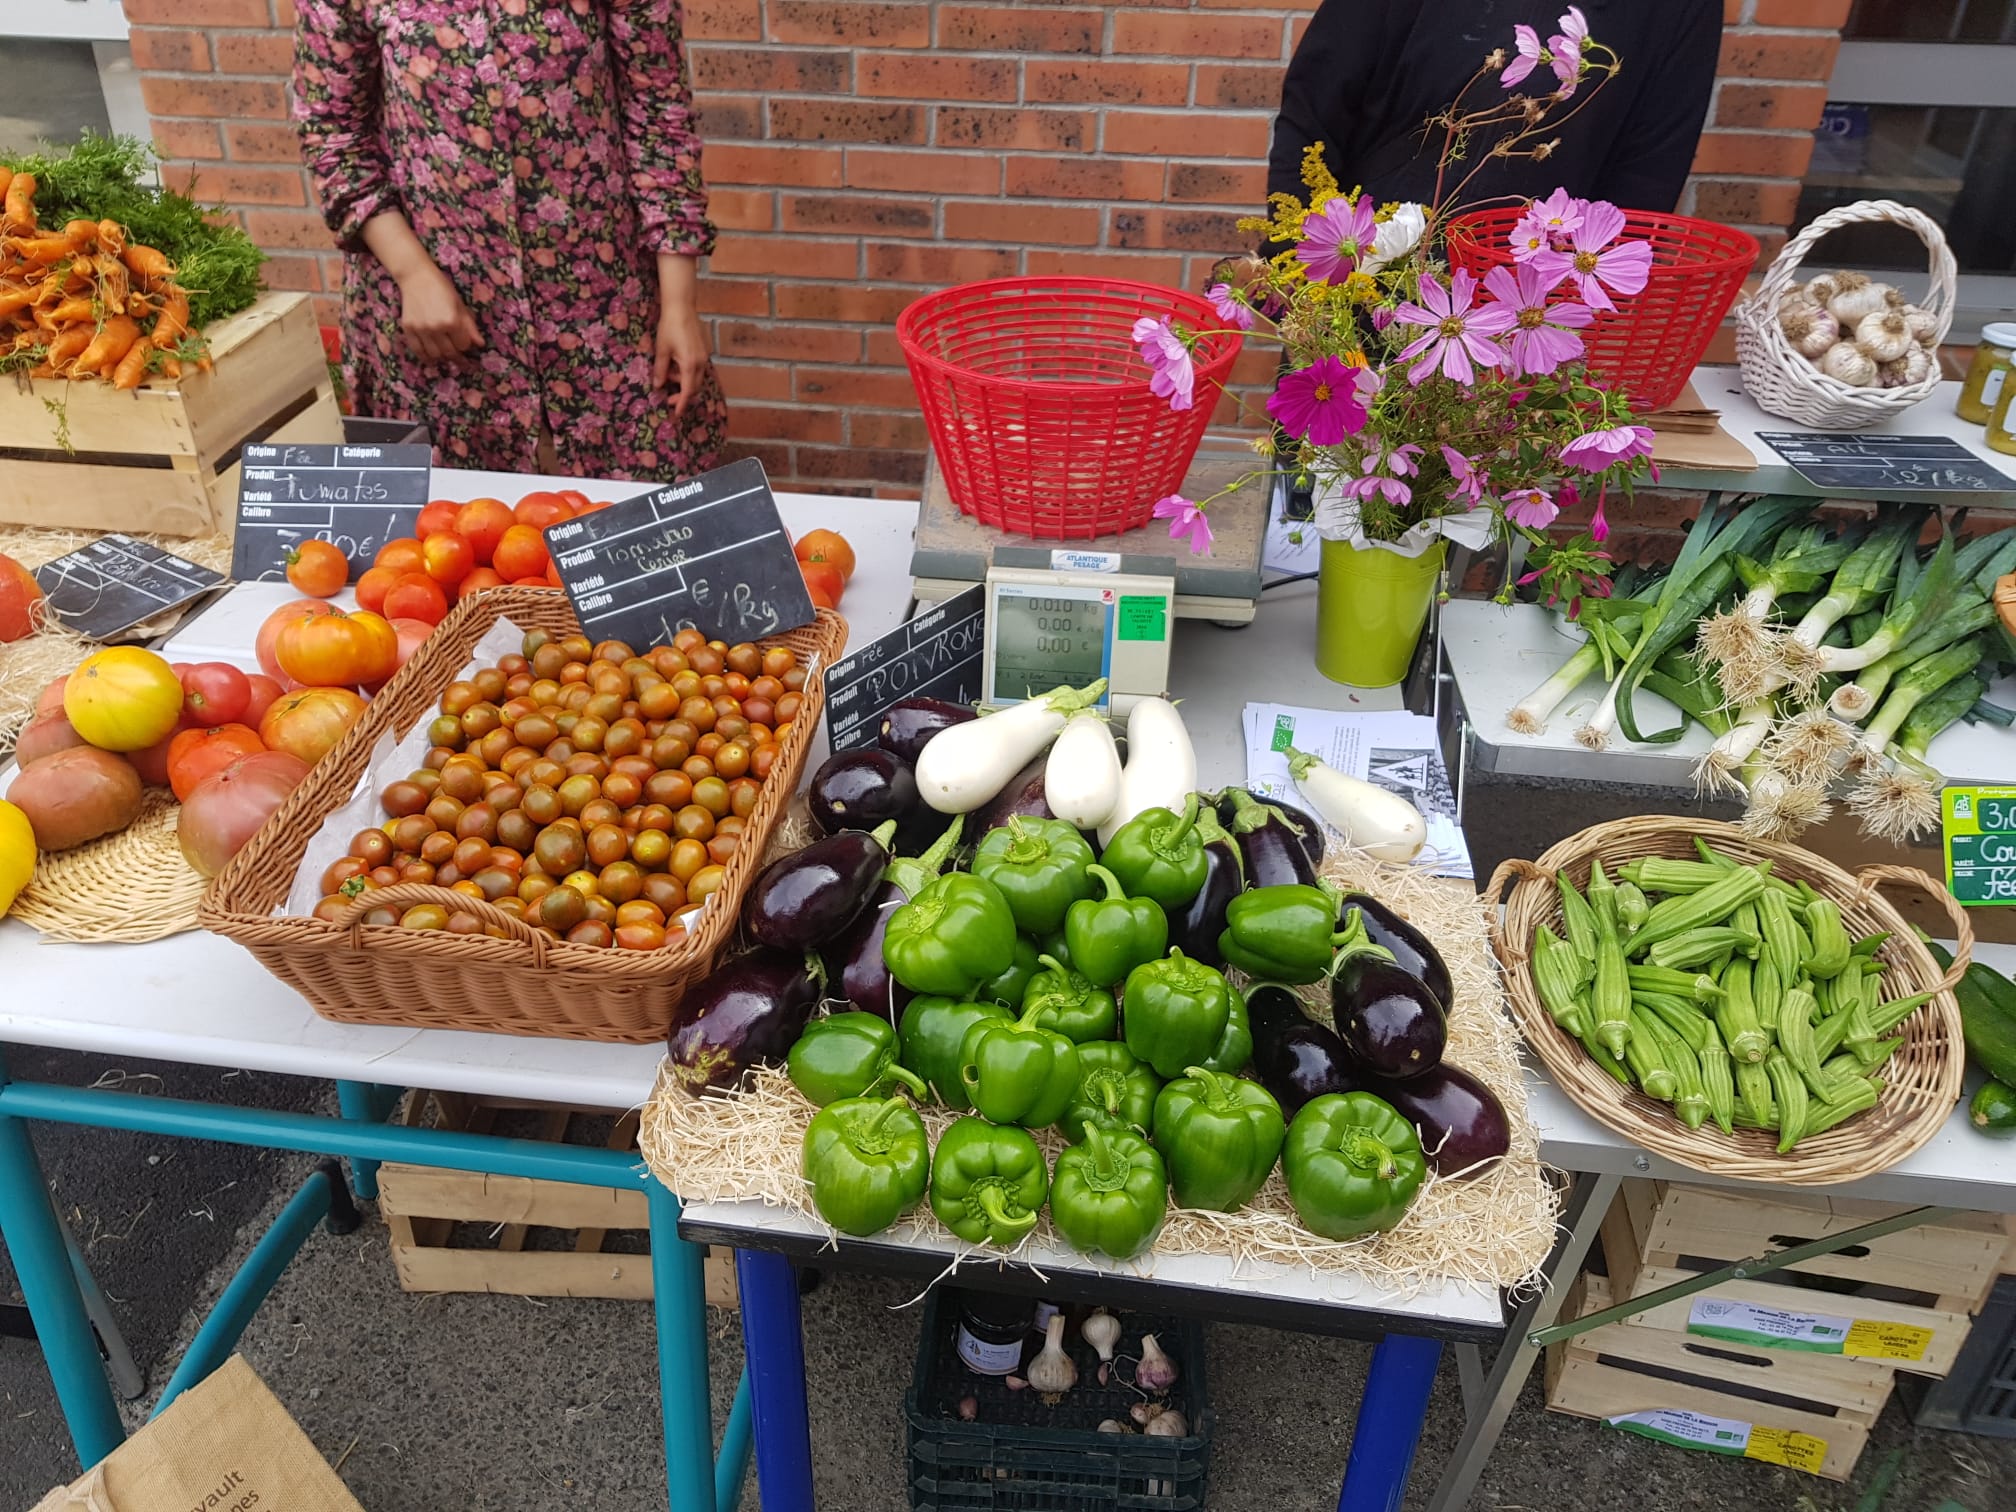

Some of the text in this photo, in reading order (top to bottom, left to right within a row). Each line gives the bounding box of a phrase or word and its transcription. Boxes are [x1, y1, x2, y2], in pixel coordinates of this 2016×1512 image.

[248, 446, 276, 458] Origine
[342, 447, 381, 458] Catégorie
[245, 470, 275, 481] Produit
[243, 490, 272, 502] Variété
[657, 481, 704, 505] Catégorie
[242, 507, 272, 518] Calibre
[549, 522, 583, 542] Origine
[560, 549, 596, 569] Produit
[1066, 554, 1108, 564] ATLANTIQUE
[1073, 561, 1101, 569] PESAGE
[570, 575, 605, 595] Variété
[578, 592, 613, 612] Calibre
[914, 608, 945, 633] Catégorie
[829, 659, 855, 681] Origine
[831, 685, 858, 709] Produit
[833, 710, 859, 733] Variété
[835, 728, 861, 750] Calibre
[189, 1470, 244, 1512] vault
